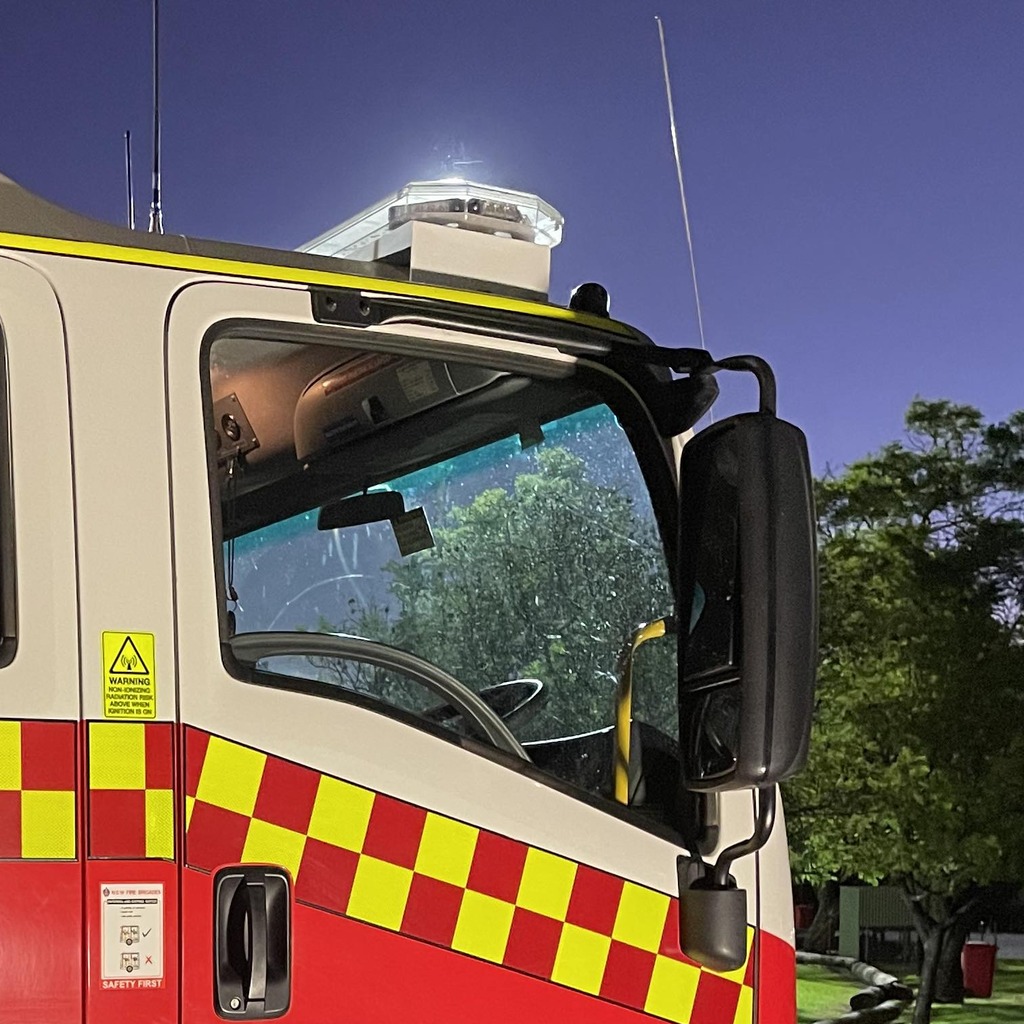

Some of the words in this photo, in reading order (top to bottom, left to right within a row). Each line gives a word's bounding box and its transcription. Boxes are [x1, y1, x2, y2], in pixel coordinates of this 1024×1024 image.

[109, 677, 150, 686] WARNING
[102, 980, 136, 989] SAFETY
[138, 979, 162, 988] FIRST
